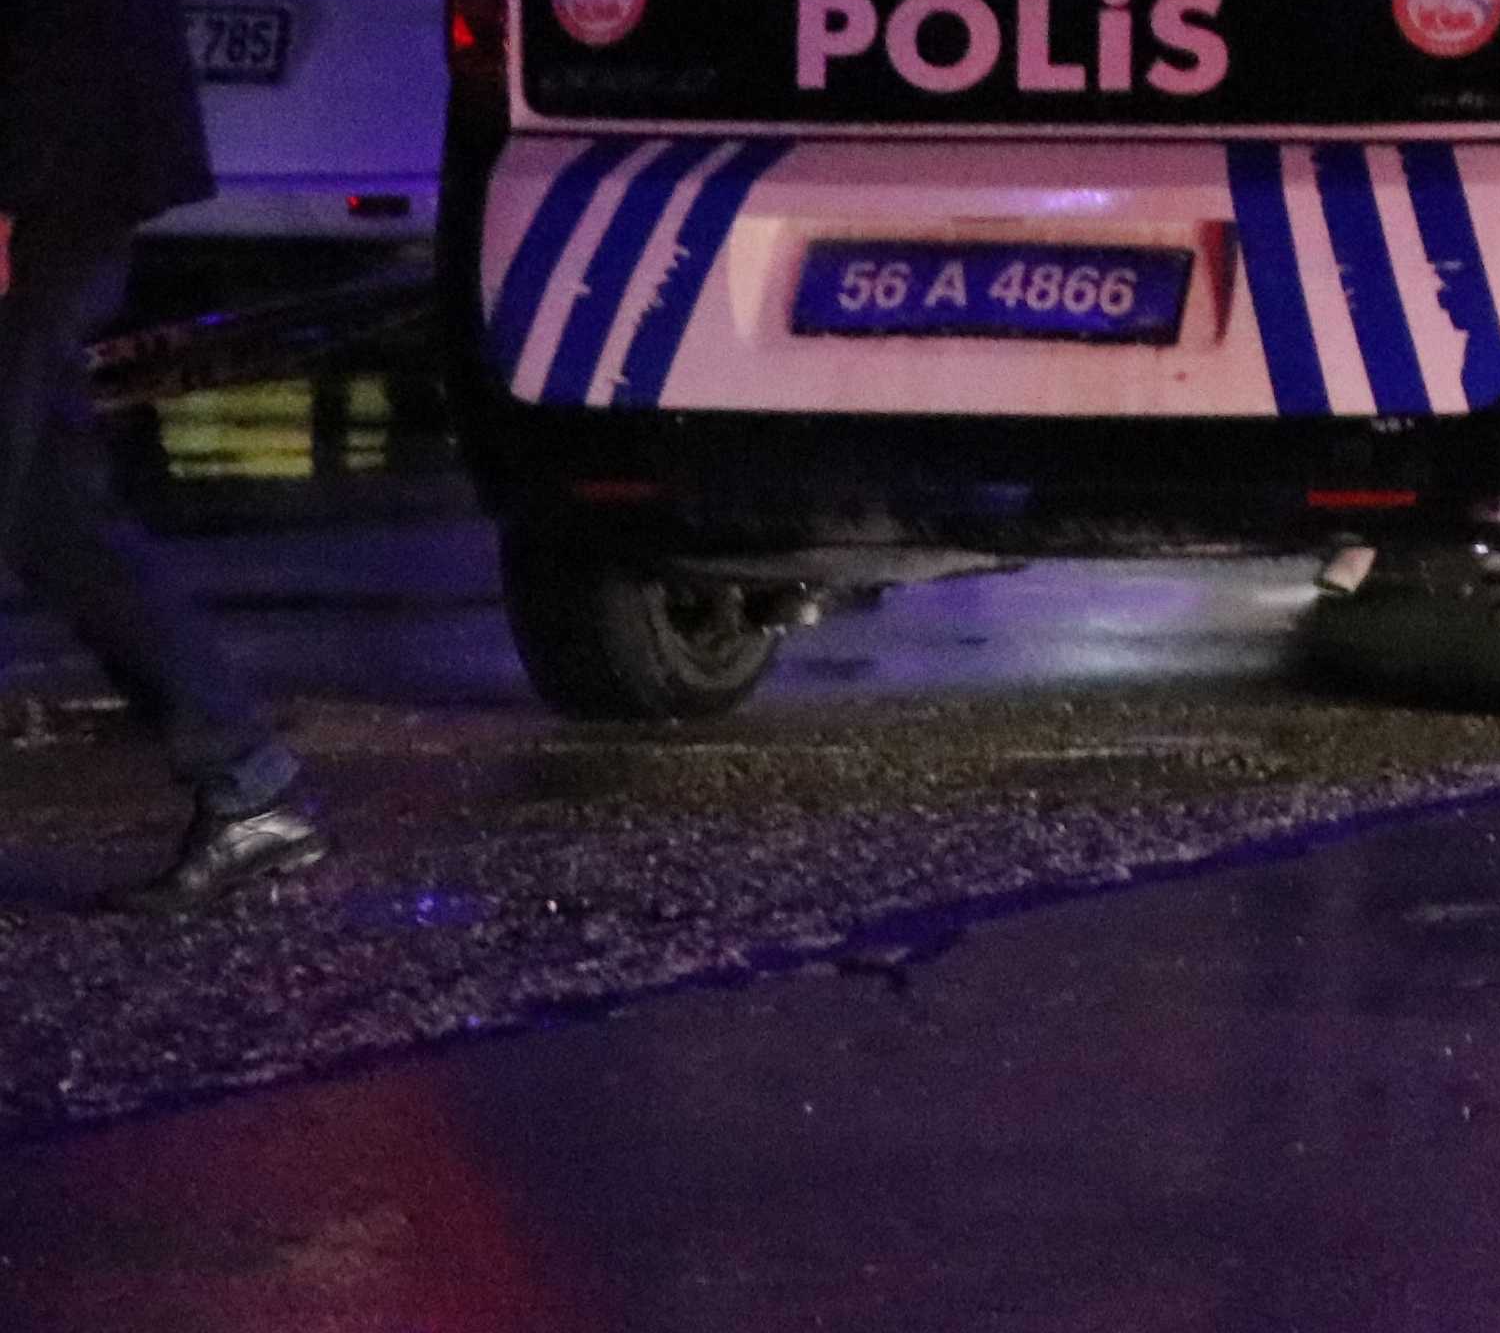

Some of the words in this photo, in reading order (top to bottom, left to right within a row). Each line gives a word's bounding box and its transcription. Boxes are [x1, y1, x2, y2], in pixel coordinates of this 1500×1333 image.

[206, 20, 272, 63] 785
[836, 259, 910, 310] 56
[924, 262, 968, 309] A
[988, 262, 1138, 315] 4866
